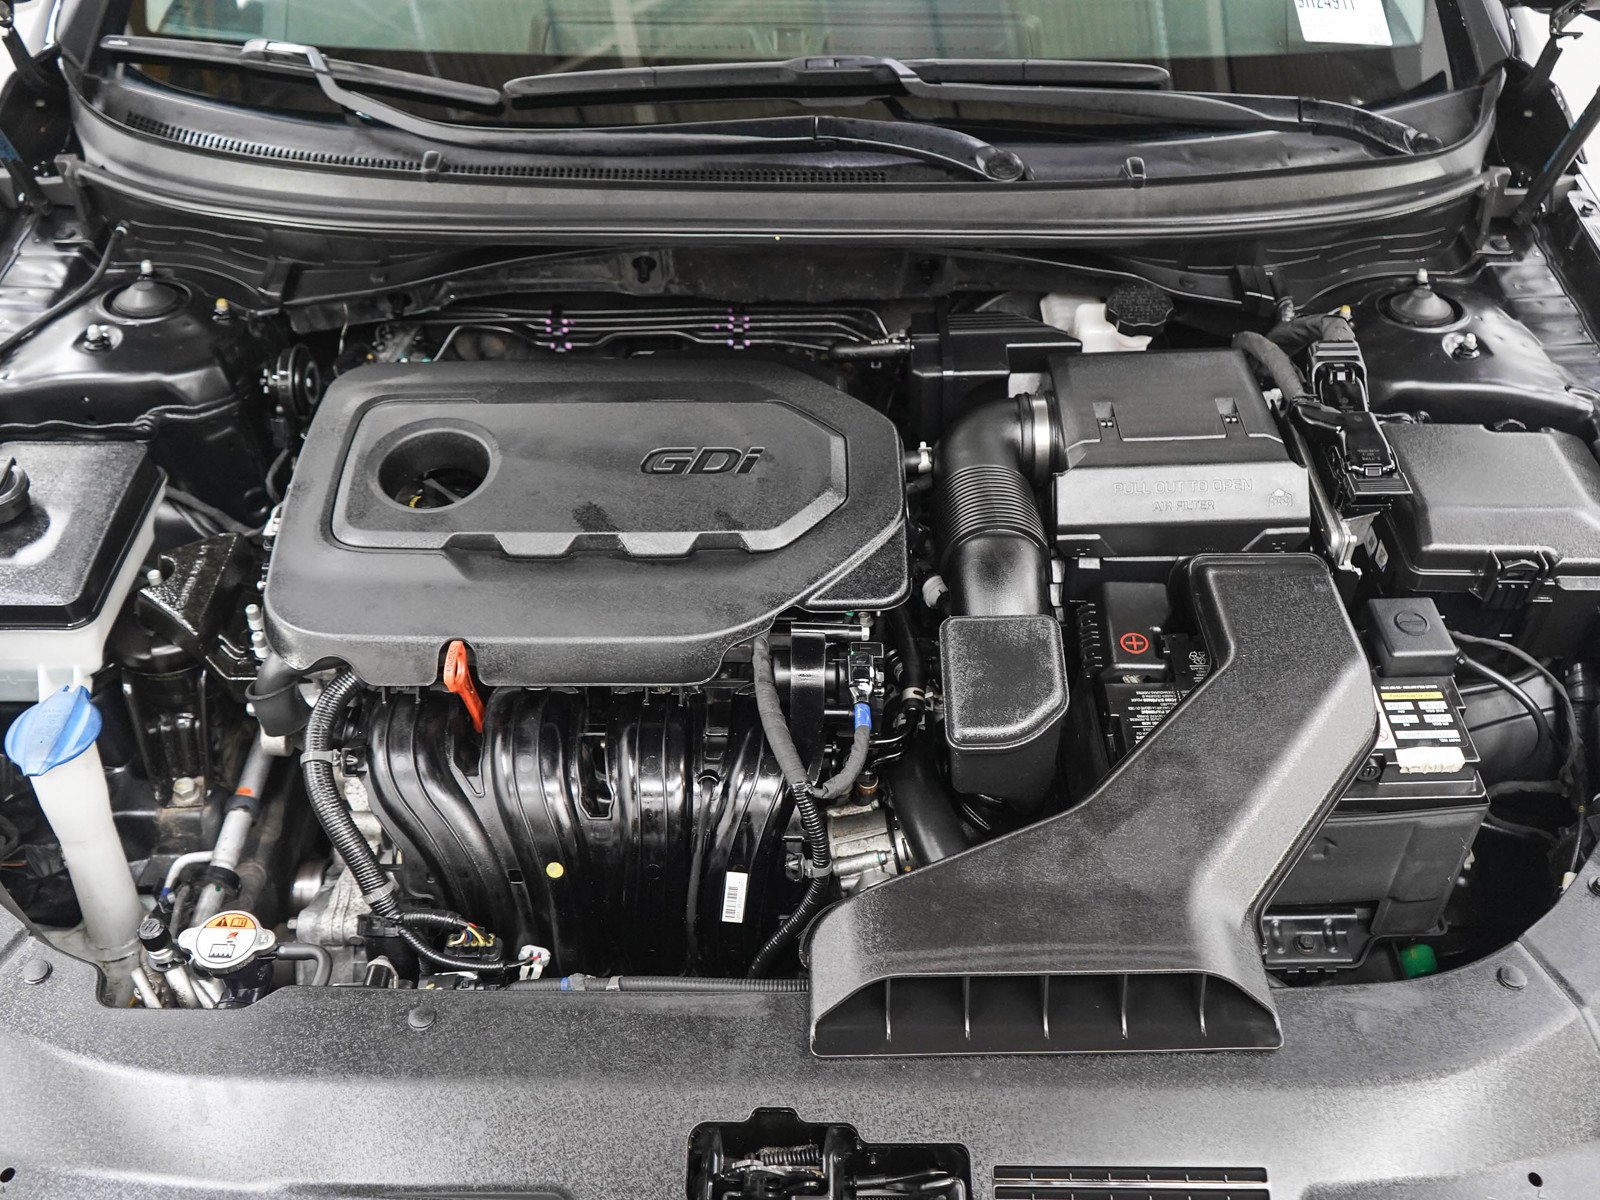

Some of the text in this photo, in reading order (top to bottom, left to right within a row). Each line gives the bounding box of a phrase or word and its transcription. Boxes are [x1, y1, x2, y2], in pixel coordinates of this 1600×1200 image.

[640, 446, 766, 474] GDi
[1113, 478, 1253, 495] PULL OUT TO OPEN
[1152, 499, 1216, 512] AIR FILTER
